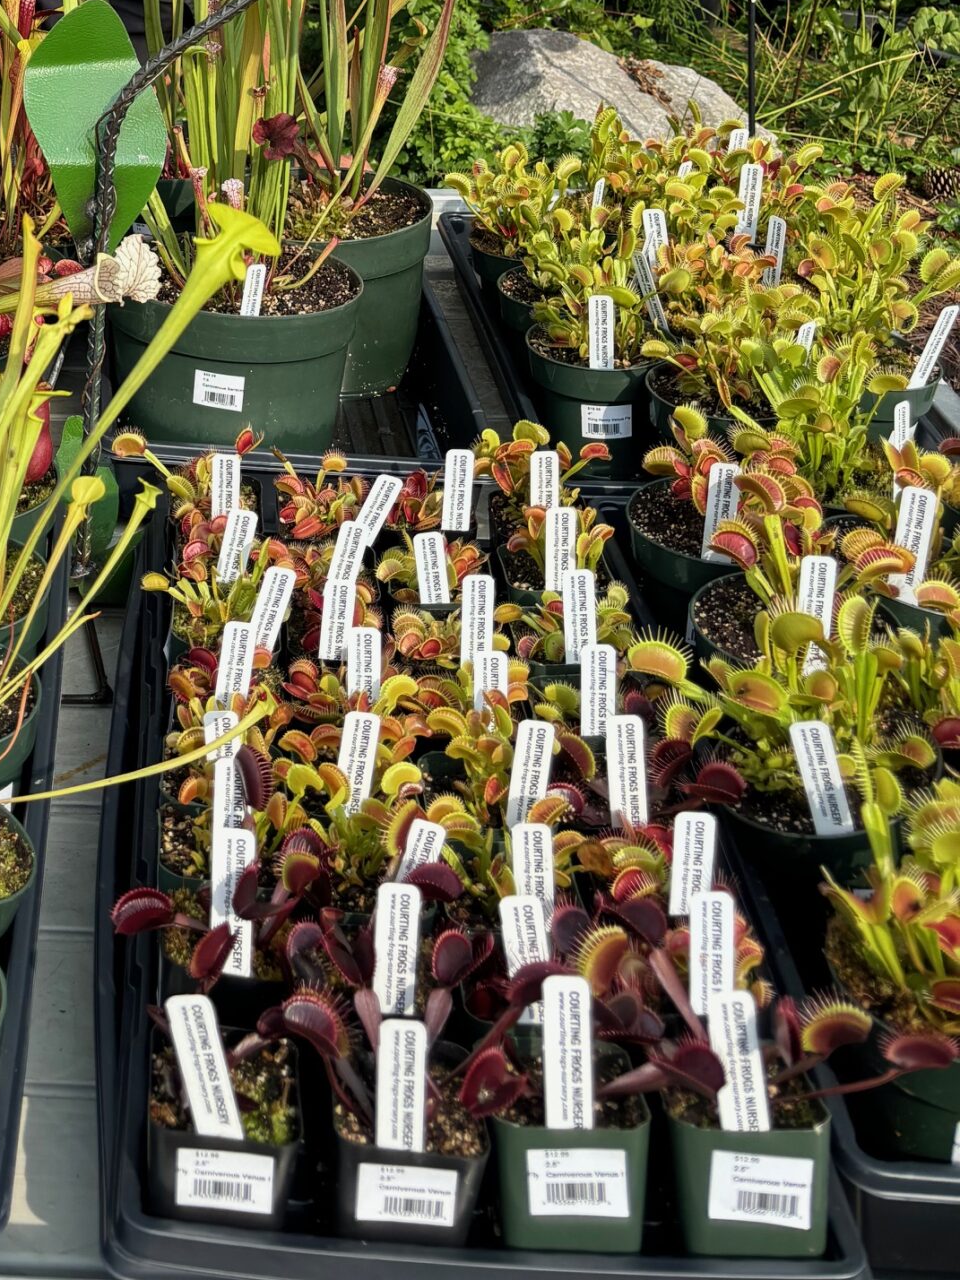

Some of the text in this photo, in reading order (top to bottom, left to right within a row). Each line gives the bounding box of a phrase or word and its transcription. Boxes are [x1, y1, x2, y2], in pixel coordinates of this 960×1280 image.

[750, 168, 758, 191] COURTING
[652, 213, 663, 238] COURTING
[253, 269, 261, 298] COURTING
[376, 481, 396, 513] COURTING
[455, 455, 467, 530] COURTING FROGS NURS
[721, 469, 733, 519] COURTING FROGS
[237, 516, 250, 548] COURTING
[561, 513, 569, 547] COURTING
[910, 495, 927, 554] COURTING FROGS
[342, 527, 363, 581] COURTING FROGS
[427, 537, 442, 592] COURTING FROGS
[272, 574, 288, 609] COURTING
[478, 581, 486, 615] COURTING
[578, 576, 587, 611] COURTING
[816, 563, 827, 598] COURTING
[264, 609, 277, 632] FROGS
[337, 586, 347, 620] COURTING
[335, 622, 344, 644] FROGS
[580, 614, 588, 636] FROGS
[232, 629, 249, 692] COURTING FROGS
[364, 634, 372, 672] COURTING
[598, 651, 606, 690] COURTING
[598, 693, 607, 718] FROGS
[358, 719, 372, 759] COURTING
[532, 728, 546, 768] COURTING
[354, 760, 366, 786] FROGS
[528, 770, 541, 796] FROGS
[625, 723, 640, 827] COURTING FROGS NURSER
[809, 727, 843, 828] COURTING FROGS NURSERY
[532, 831, 544, 872] COURTING
[693, 821, 704, 865] COURTING
[523, 905, 538, 952] COURTING
[712, 901, 722, 950] COURTING
[395, 894, 410, 1014] COURTING FROGS NURSER
[712, 954, 722, 984] FROGS
[191, 1004, 230, 1126] COURTING FROGS NURSERY
[569, 992, 583, 1129] COURTING FROGS NURSER
[732, 1002, 759, 1132] COURTING FROGS NURSE
[402, 1031, 415, 1150] COURTING FROGS NURSER
